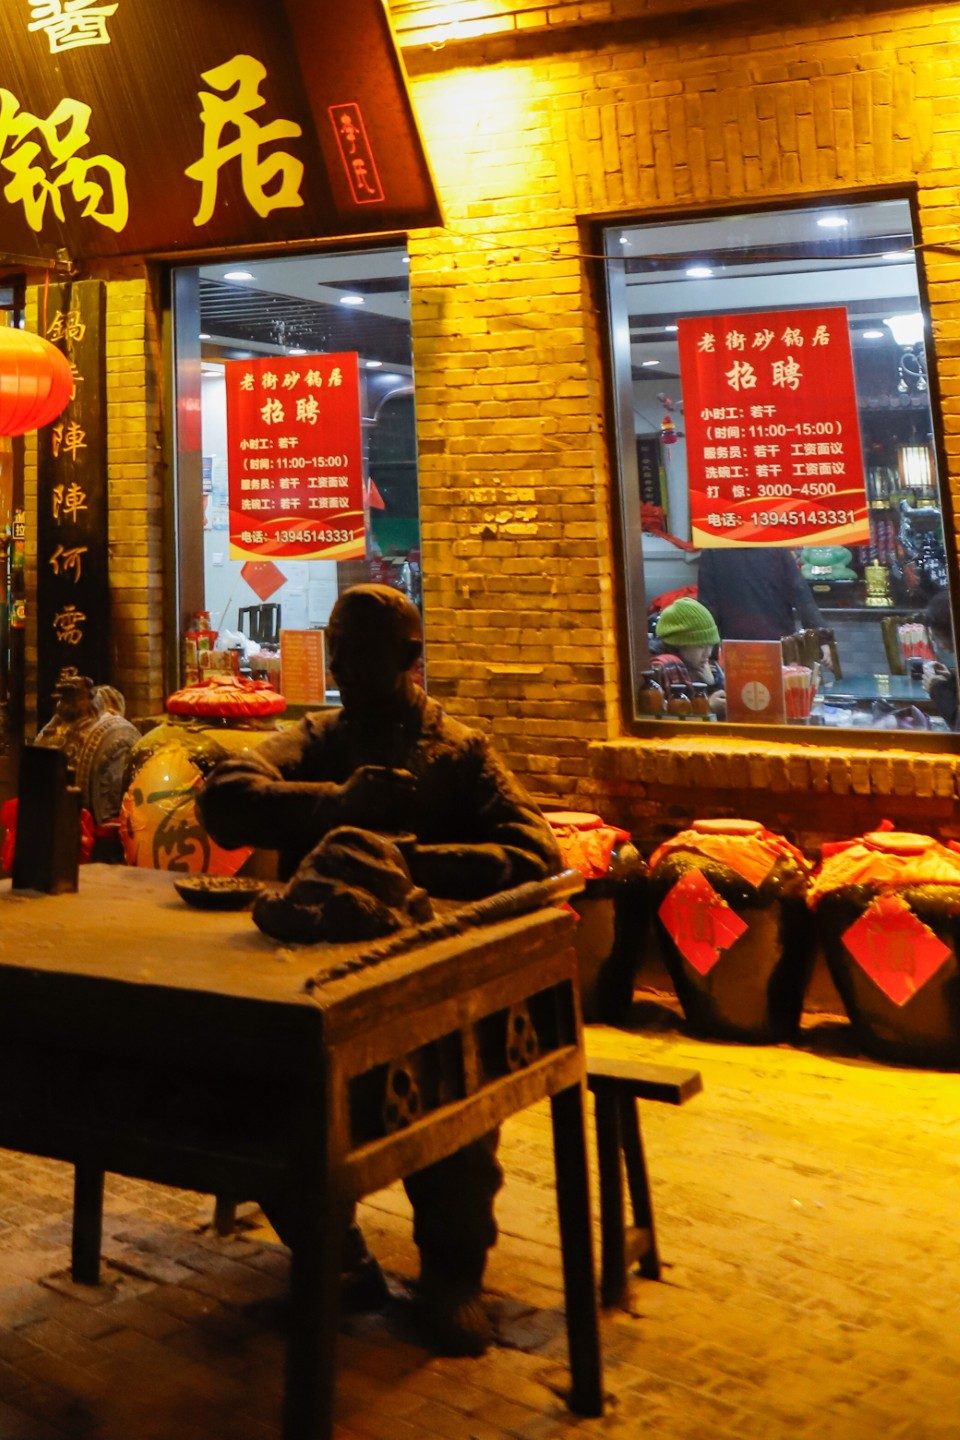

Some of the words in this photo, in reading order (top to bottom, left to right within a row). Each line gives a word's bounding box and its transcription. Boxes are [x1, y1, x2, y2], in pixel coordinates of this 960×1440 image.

[697, 325, 831, 353] 老街砂锅居
[240, 367, 343, 392] 老街砂锅居
[725, 356, 803, 391] 招聘
[260, 394, 320, 425] 招聘
[791, 441, 844, 456] 工资面议
[793, 462, 846, 476] 工资面议
[308, 476, 349, 489] 工资面议
[308, 496, 349, 510] 工资面议
